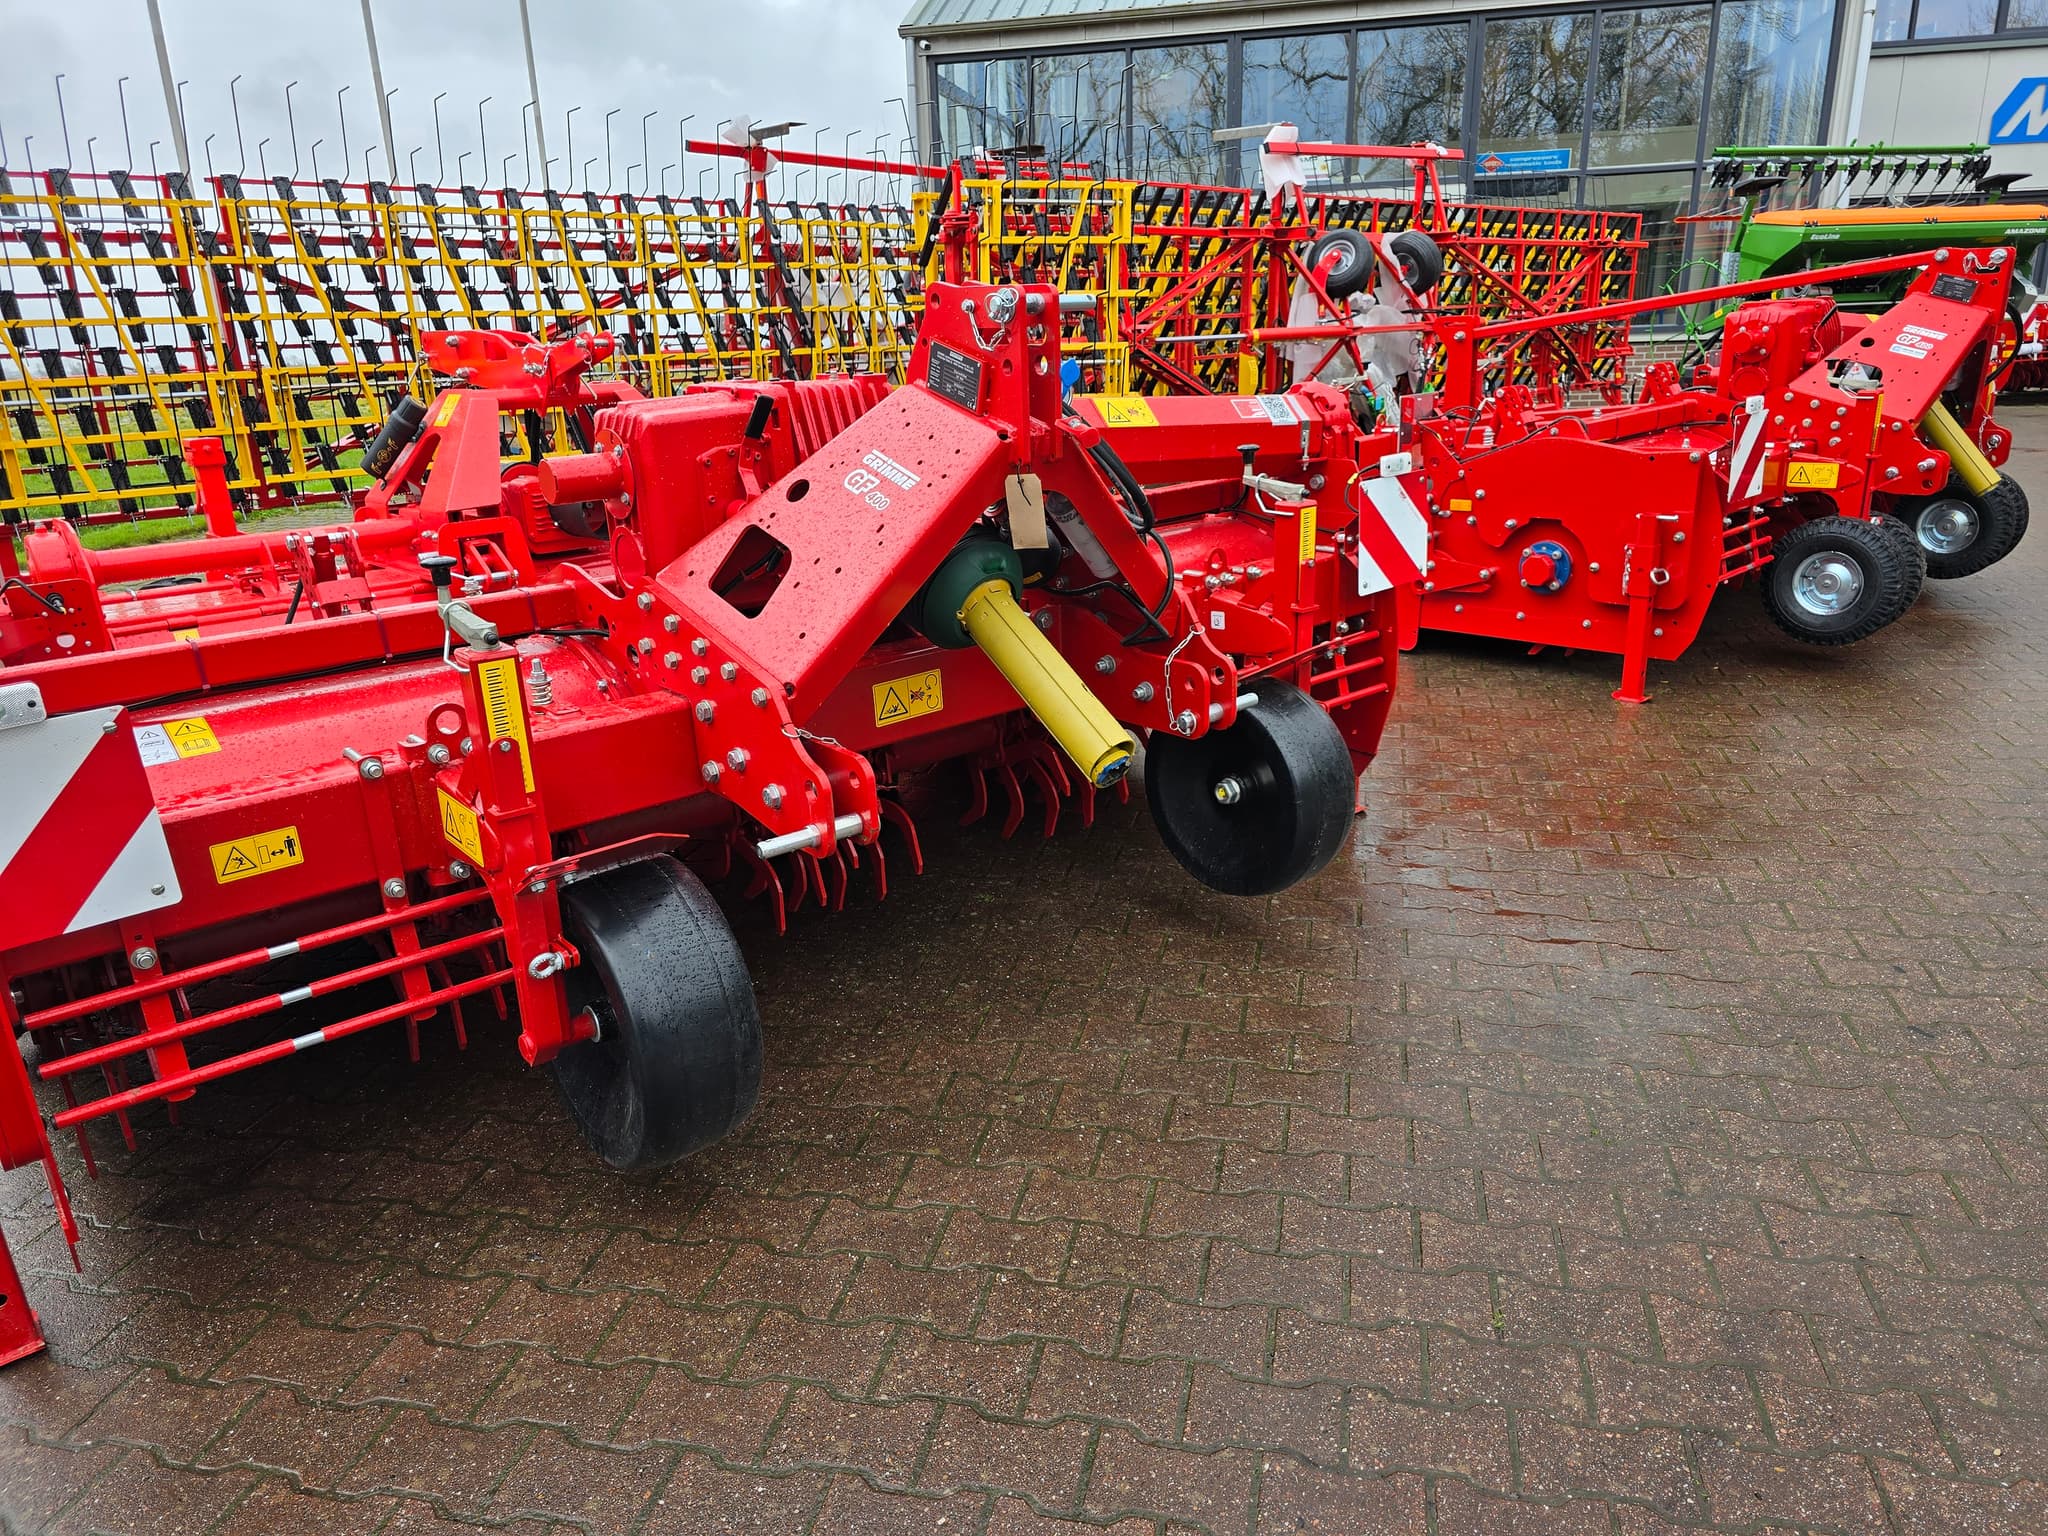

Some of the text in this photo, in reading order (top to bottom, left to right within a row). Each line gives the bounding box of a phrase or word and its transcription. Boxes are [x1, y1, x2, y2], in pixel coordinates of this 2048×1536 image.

[1810, 233, 1841, 241] EcoLine
[2004, 227, 2048, 235] AMAZONE
[1896, 333, 1922, 345] GF
[862, 452, 918, 491] GRIMME
[844, 468, 890, 511] GF 400
